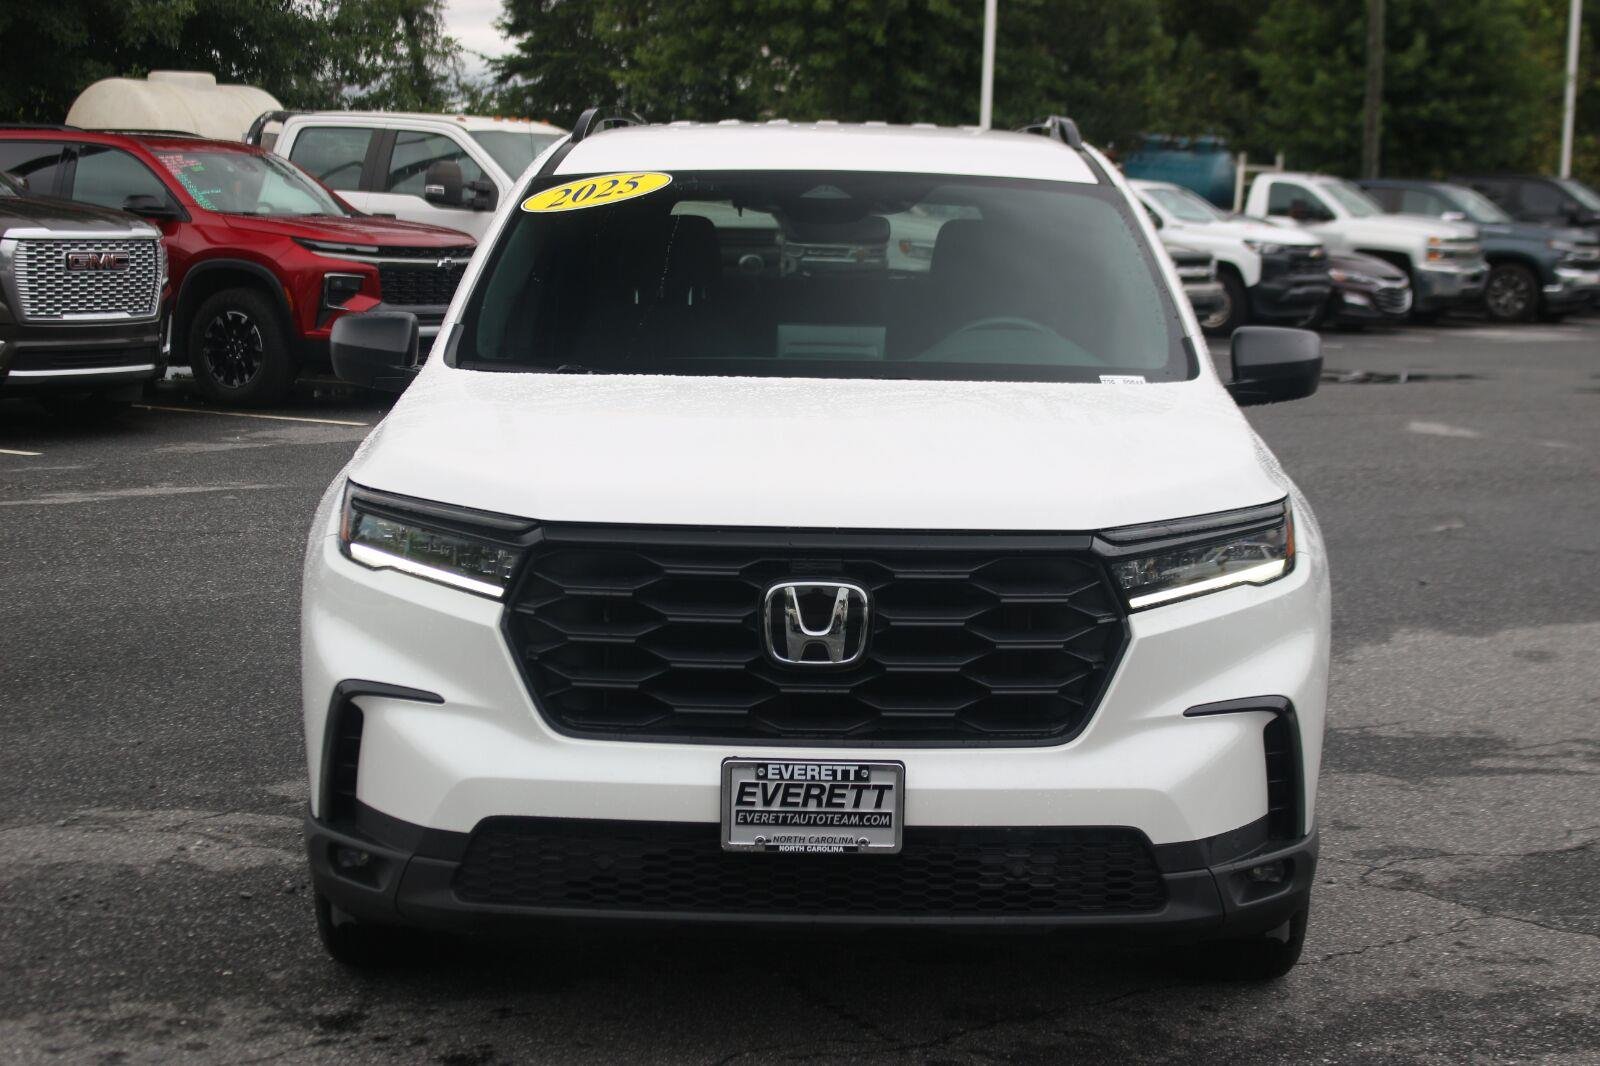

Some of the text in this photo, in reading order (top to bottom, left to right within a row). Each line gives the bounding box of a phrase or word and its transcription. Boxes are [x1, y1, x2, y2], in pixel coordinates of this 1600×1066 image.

[545, 174, 645, 208] 2025
[68, 253, 129, 271] GMC
[767, 764, 859, 781] EVERETT
[735, 781, 894, 809] EVERETT
[737, 812, 890, 826] EVERETTAUTOTEAM.COM
[773, 835, 854, 845] NORTH CAROLINA
